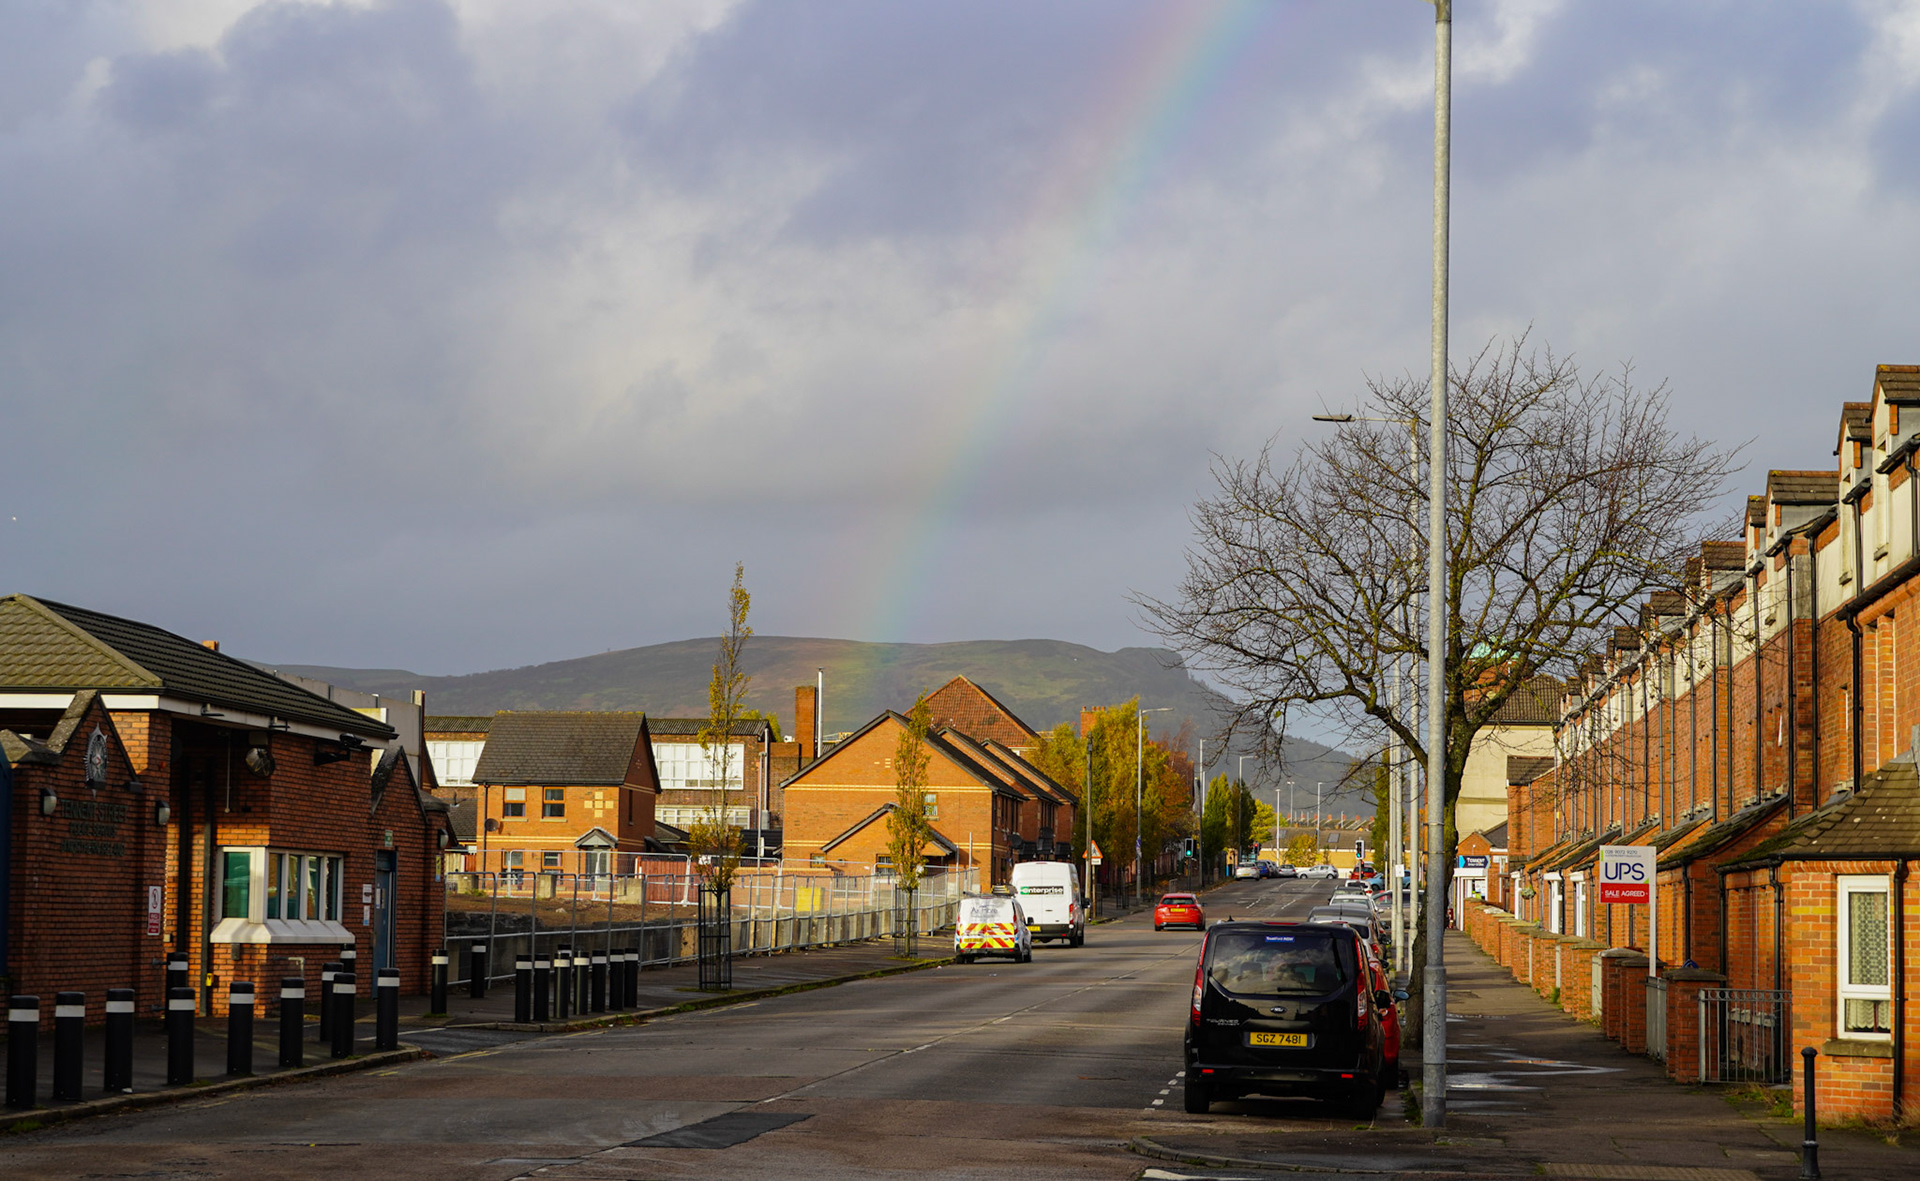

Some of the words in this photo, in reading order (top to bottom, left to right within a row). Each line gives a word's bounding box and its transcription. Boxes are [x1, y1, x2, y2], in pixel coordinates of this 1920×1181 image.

[98, 802, 129, 823] STREET
[1605, 862, 1645, 881] UPS
[1021, 886, 1064, 894] enterprise
[1256, 1034, 1276, 1044] SGZ
[1278, 1034, 1301, 1044] 7481
